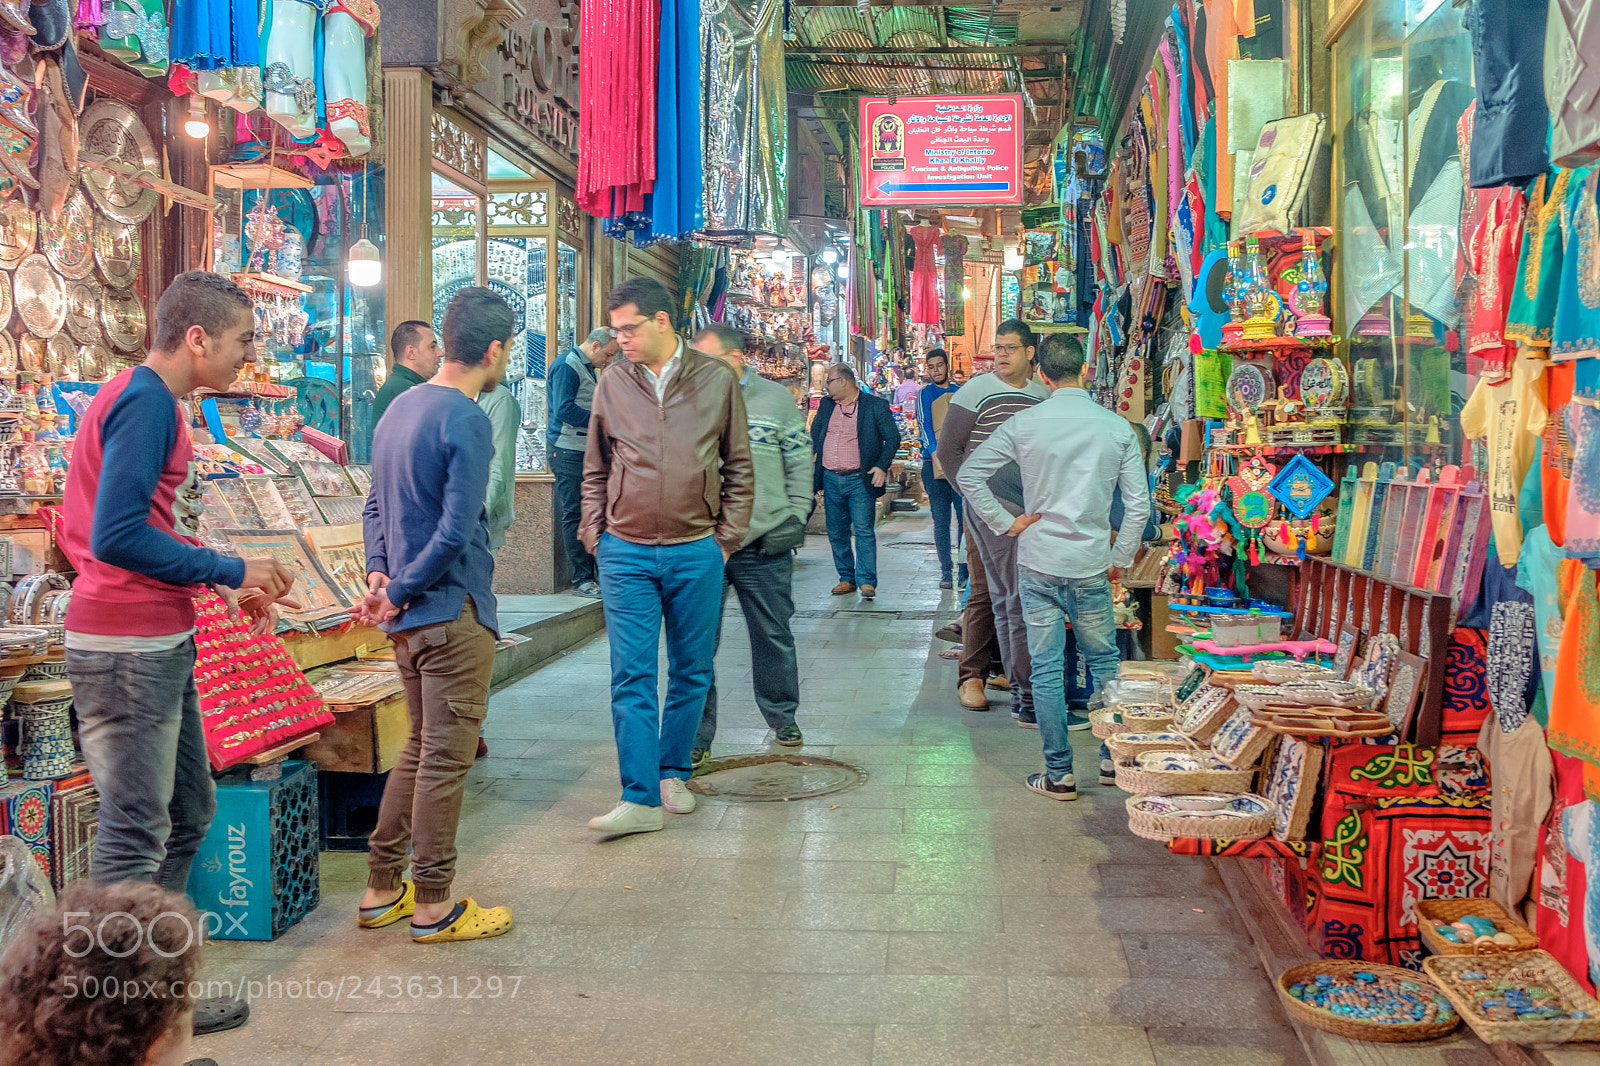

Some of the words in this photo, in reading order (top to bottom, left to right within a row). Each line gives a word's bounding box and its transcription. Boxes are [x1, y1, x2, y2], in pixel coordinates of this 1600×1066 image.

[936, 104, 967, 113] الداخلية
[968, 104, 983, 113] وزارة
[927, 115, 951, 123] السياحة
[930, 125, 942, 134] خان
[959, 125, 977, 133] سياحة
[979, 124, 996, 133] شرطة
[997, 124, 1012, 132] قسم
[953, 135, 972, 143] البحث
[973, 135, 989, 143] وحدة
[924, 149, 955, 157] Ministry
[927, 173, 975, 181] Investigation
[1076, 652, 1087, 688] PEPSI
[219, 823, 253, 908] fayrouz
